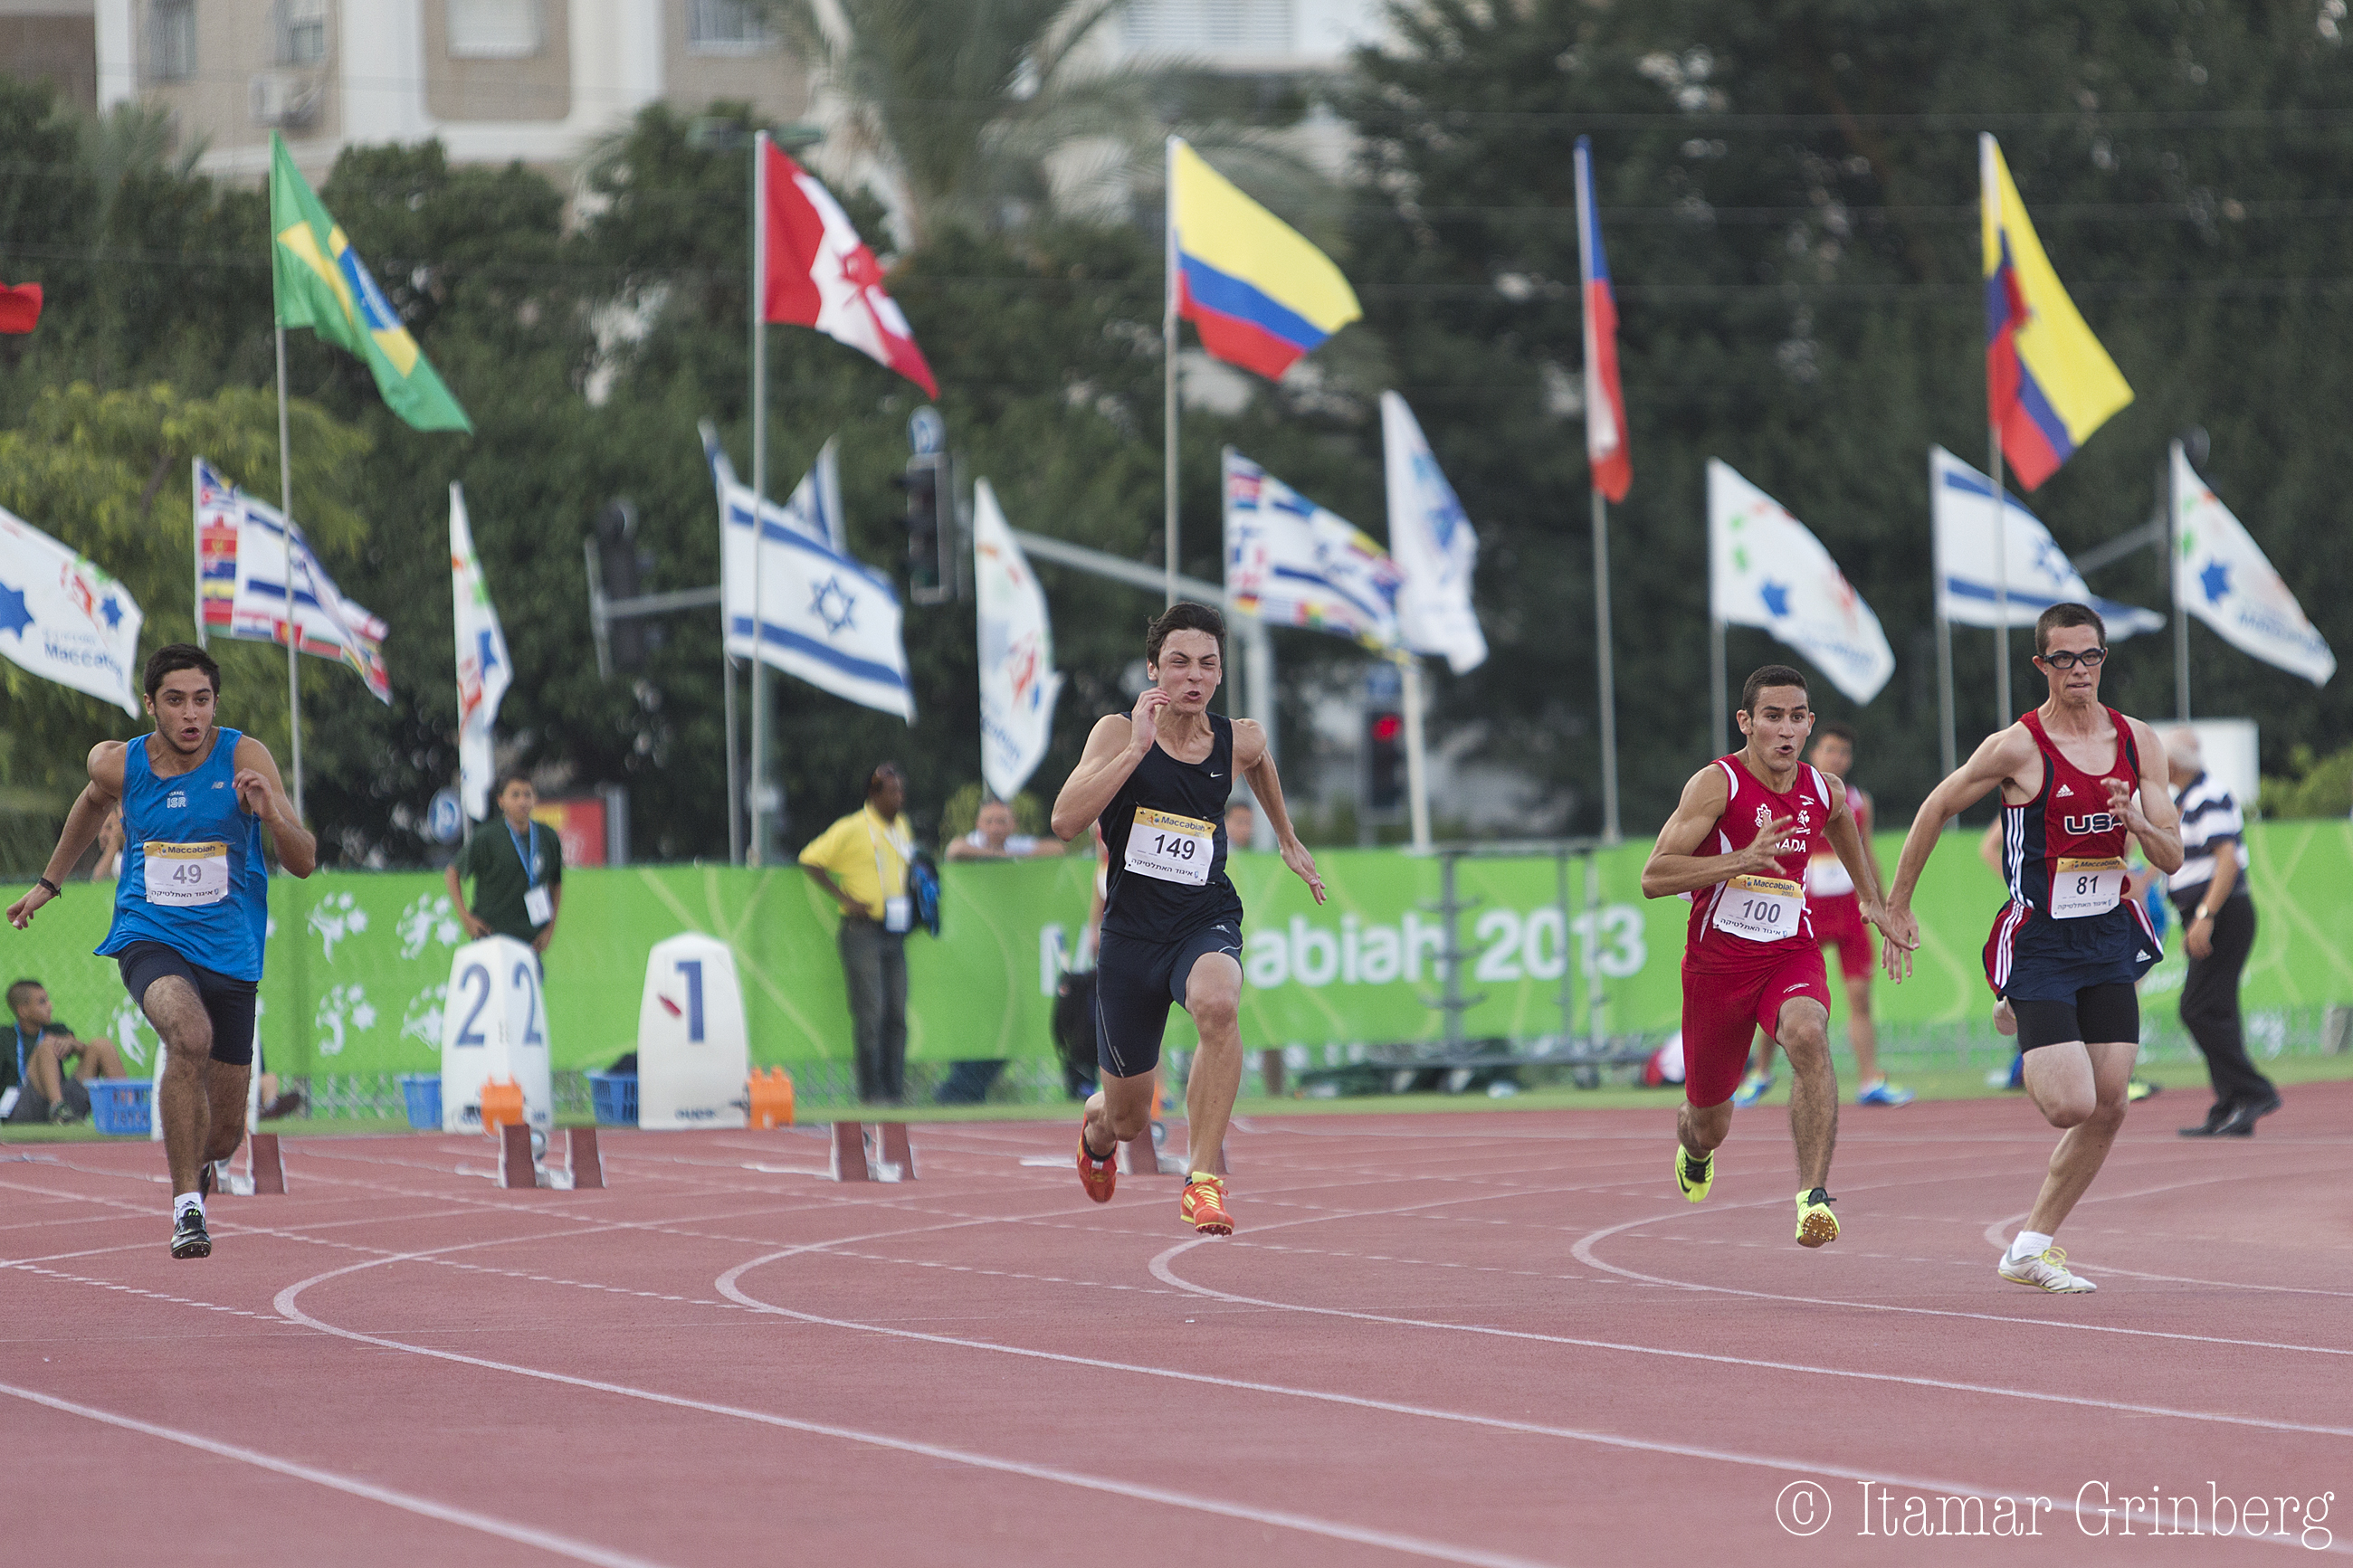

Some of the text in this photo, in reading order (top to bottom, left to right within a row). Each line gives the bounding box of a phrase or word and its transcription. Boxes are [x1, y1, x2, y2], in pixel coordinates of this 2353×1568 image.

[167, 796, 186, 809] ISR
[1160, 816, 1205, 832] Maccabiah
[167, 845, 216, 854] Maccabiah
[1154, 833, 1196, 860] 149
[172, 864, 202, 884] 49
[2080, 860, 2120, 868] Maccabiah
[1753, 879, 1795, 891] Maccabiah
[2076, 875, 2099, 895] 81
[1742, 899, 1781, 924] 100
[1473, 902, 1648, 982] 2013
[454, 962, 491, 1048] 2
[512, 960, 542, 1046] 2
[674, 960, 705, 1043] 1
